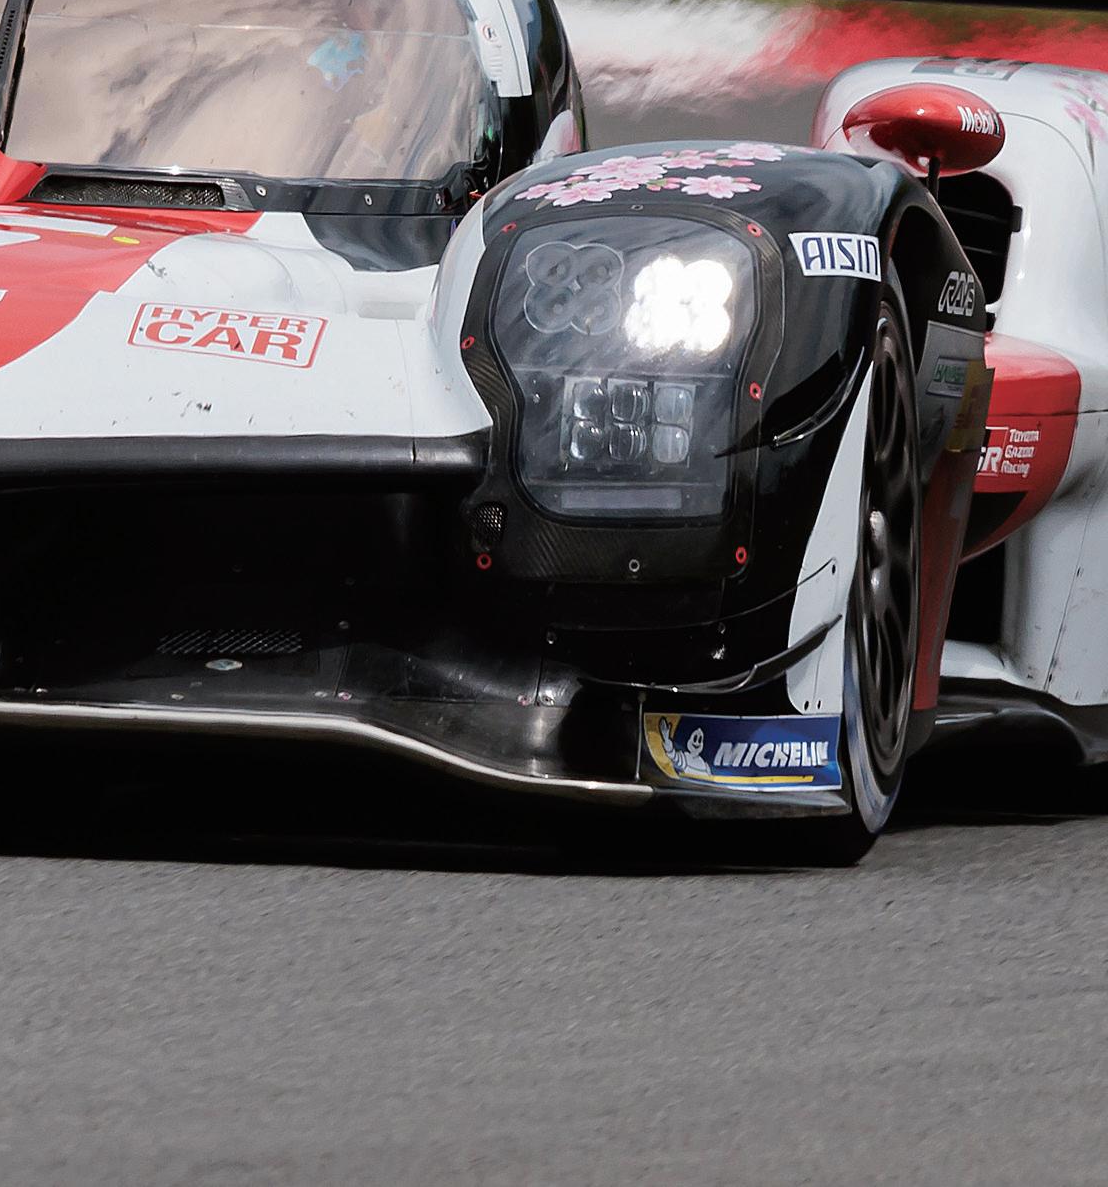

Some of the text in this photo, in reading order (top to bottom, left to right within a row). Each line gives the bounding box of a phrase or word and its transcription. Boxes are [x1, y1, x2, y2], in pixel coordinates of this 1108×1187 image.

[957, 105, 994, 135] Mobil
[802, 237, 878, 276] AISIN
[151, 307, 309, 334] HYPER
[145, 321, 303, 361] CAR
[713, 741, 830, 768] MICHELIN
